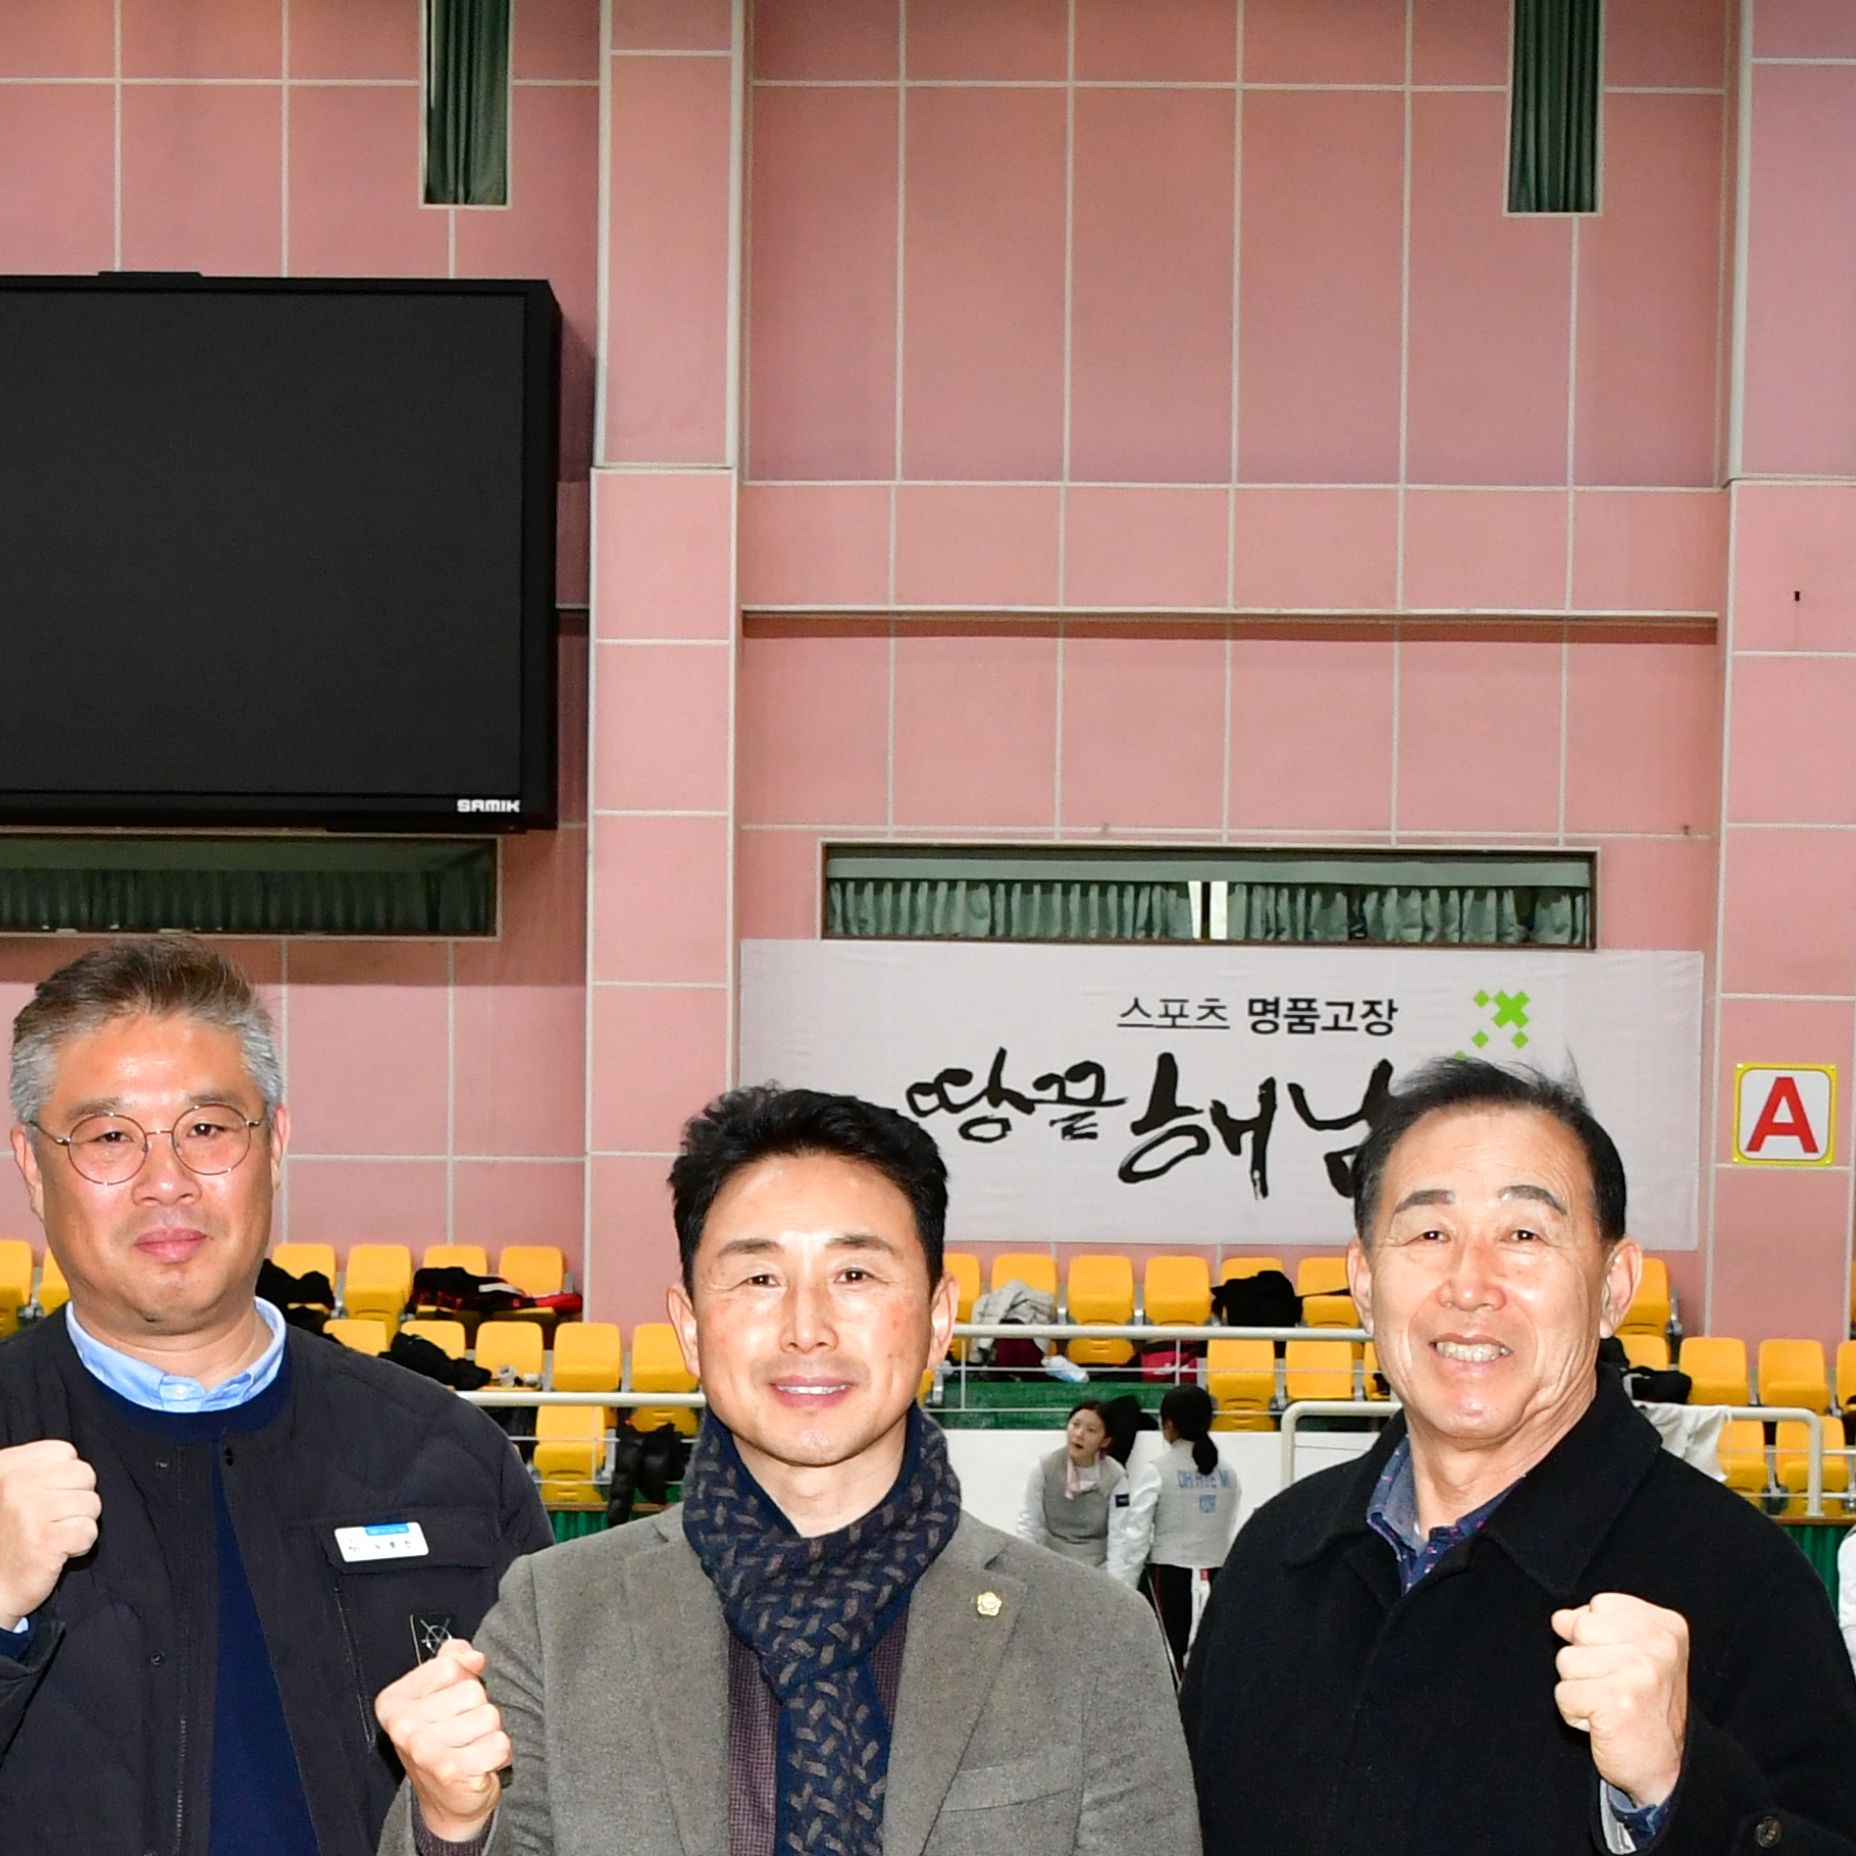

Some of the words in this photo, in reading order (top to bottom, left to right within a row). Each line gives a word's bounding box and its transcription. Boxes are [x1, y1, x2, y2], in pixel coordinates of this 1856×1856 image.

[457, 798, 520, 813] SAMIK
[1117, 997, 1231, 1030] 스포츠
[1247, 996, 1400, 1037] 명품고장
[1745, 1076, 1819, 1153] A
